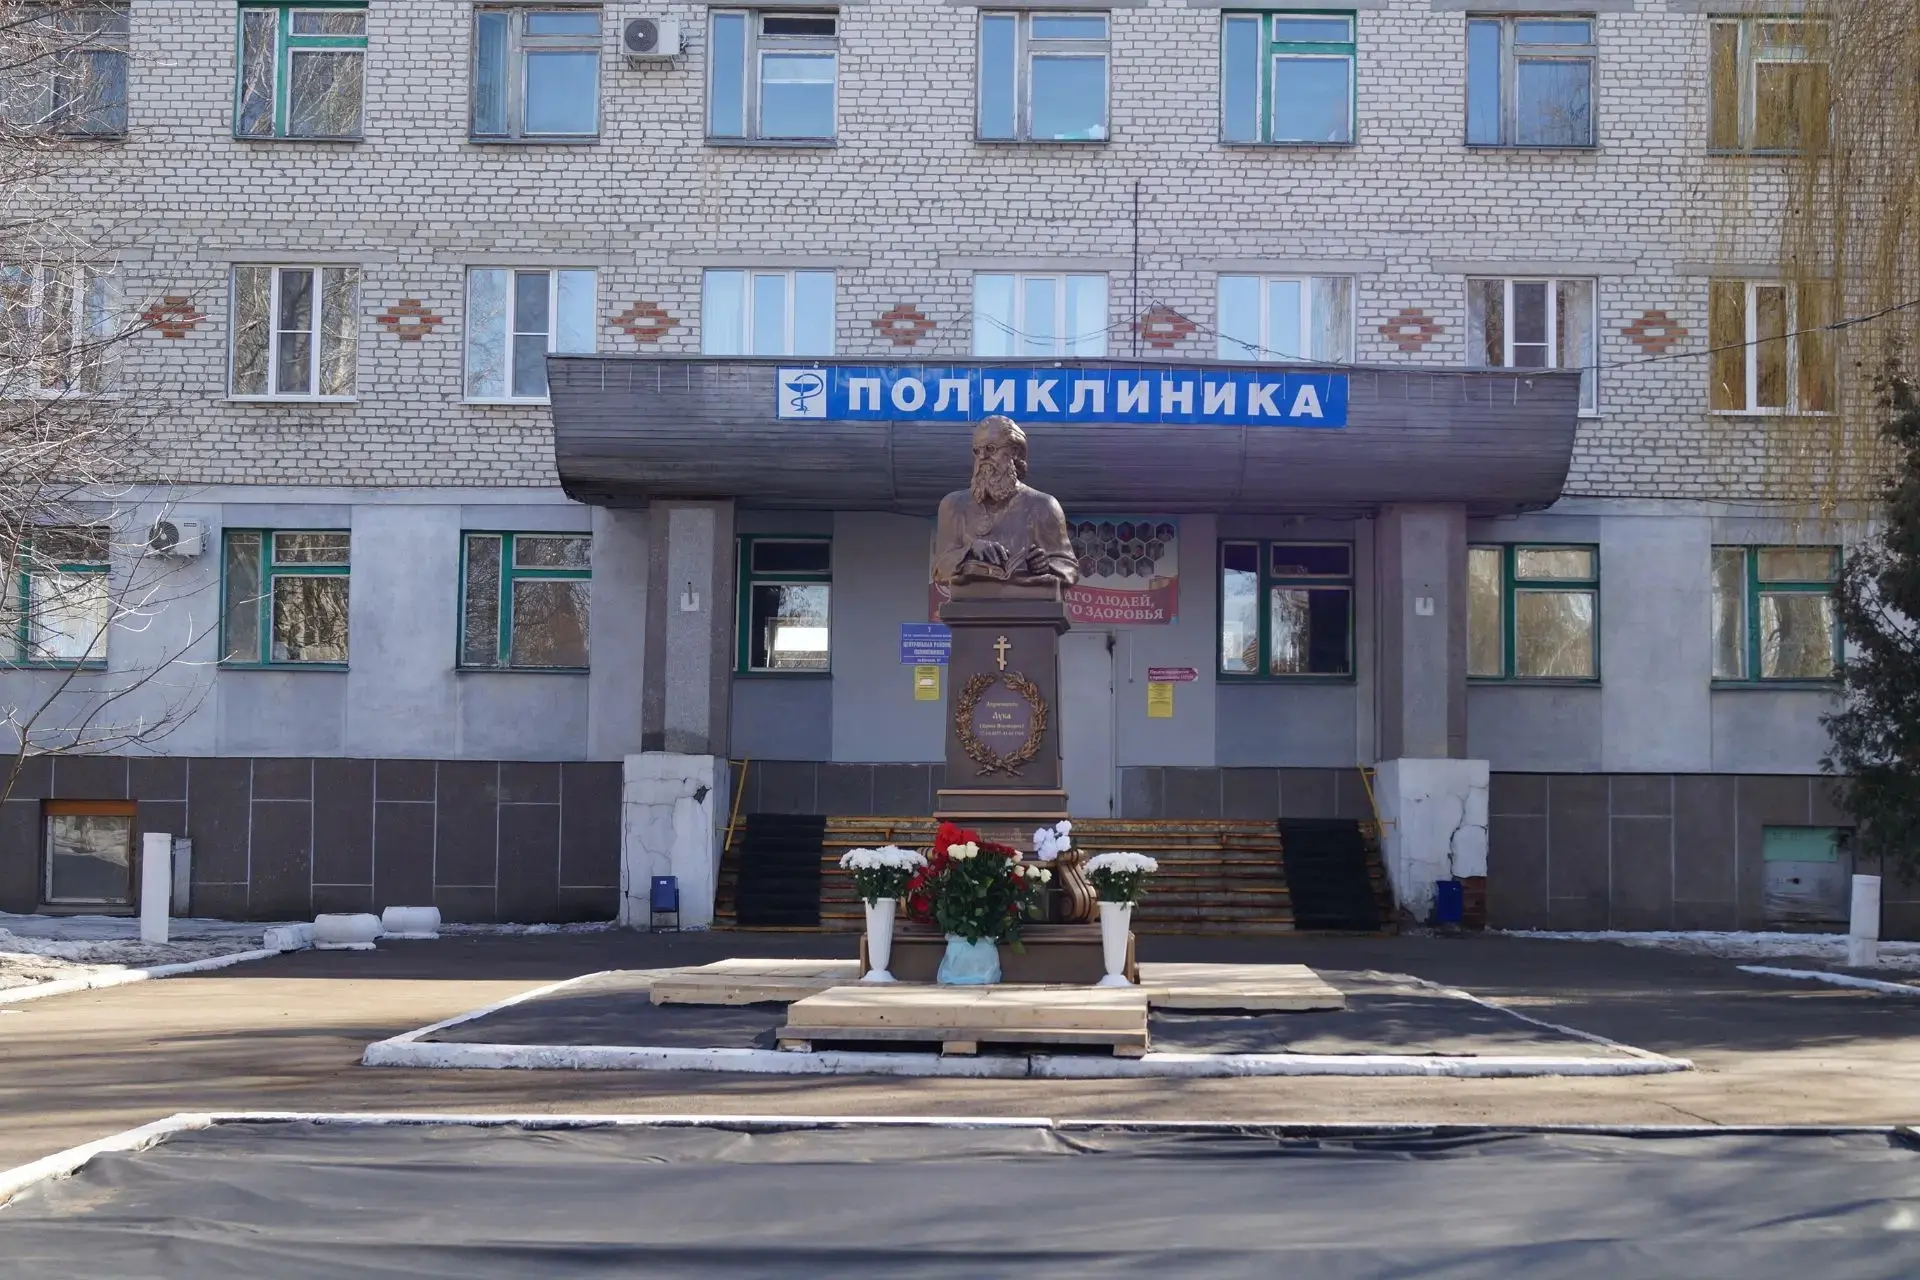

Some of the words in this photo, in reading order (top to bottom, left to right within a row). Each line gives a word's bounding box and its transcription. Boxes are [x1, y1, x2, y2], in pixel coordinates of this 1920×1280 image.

[848, 376, 1324, 418] ПОЛИКЛИНИКА
[1064, 590, 1092, 603] АГО
[1095, 594, 1155, 608] ЛЮДЕЙ,
[1085, 605, 1163, 620] ЗДОРОВЬЯ
